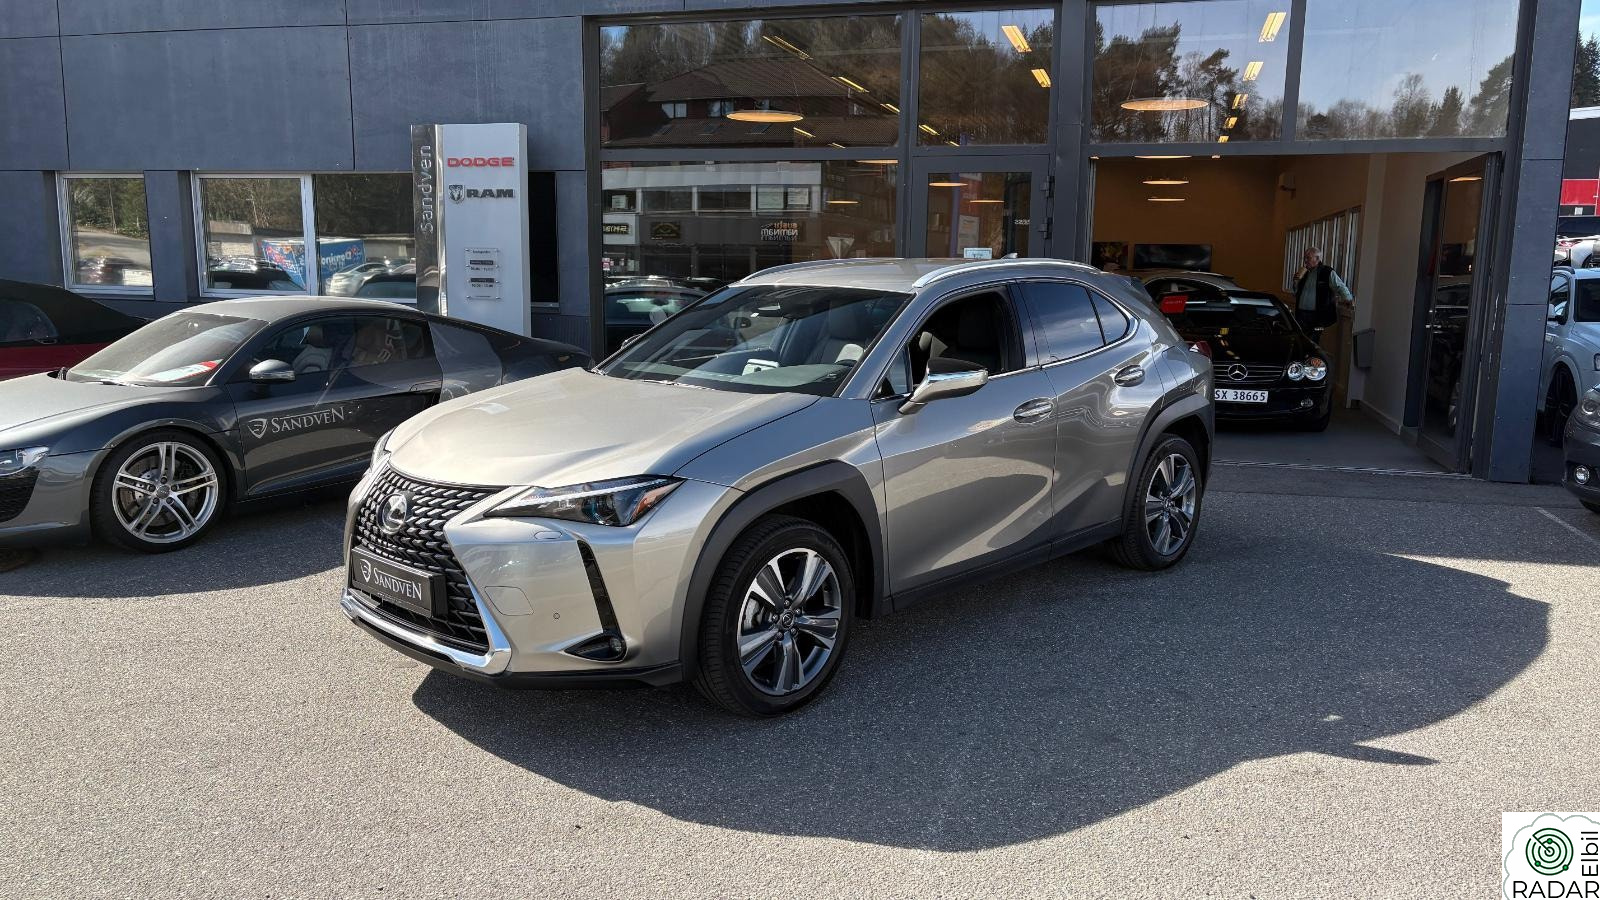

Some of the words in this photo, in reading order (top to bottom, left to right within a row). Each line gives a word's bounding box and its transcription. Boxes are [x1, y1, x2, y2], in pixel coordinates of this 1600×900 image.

[447, 156, 514, 168] DODGE
[417, 145, 434, 234] Sandven
[466, 188, 514, 199] RAM
[1215, 389, 1228, 400] SX
[1232, 390, 1266, 402] 38665
[271, 405, 345, 433] SANDVEN
[373, 567, 422, 601] SANDVEN
